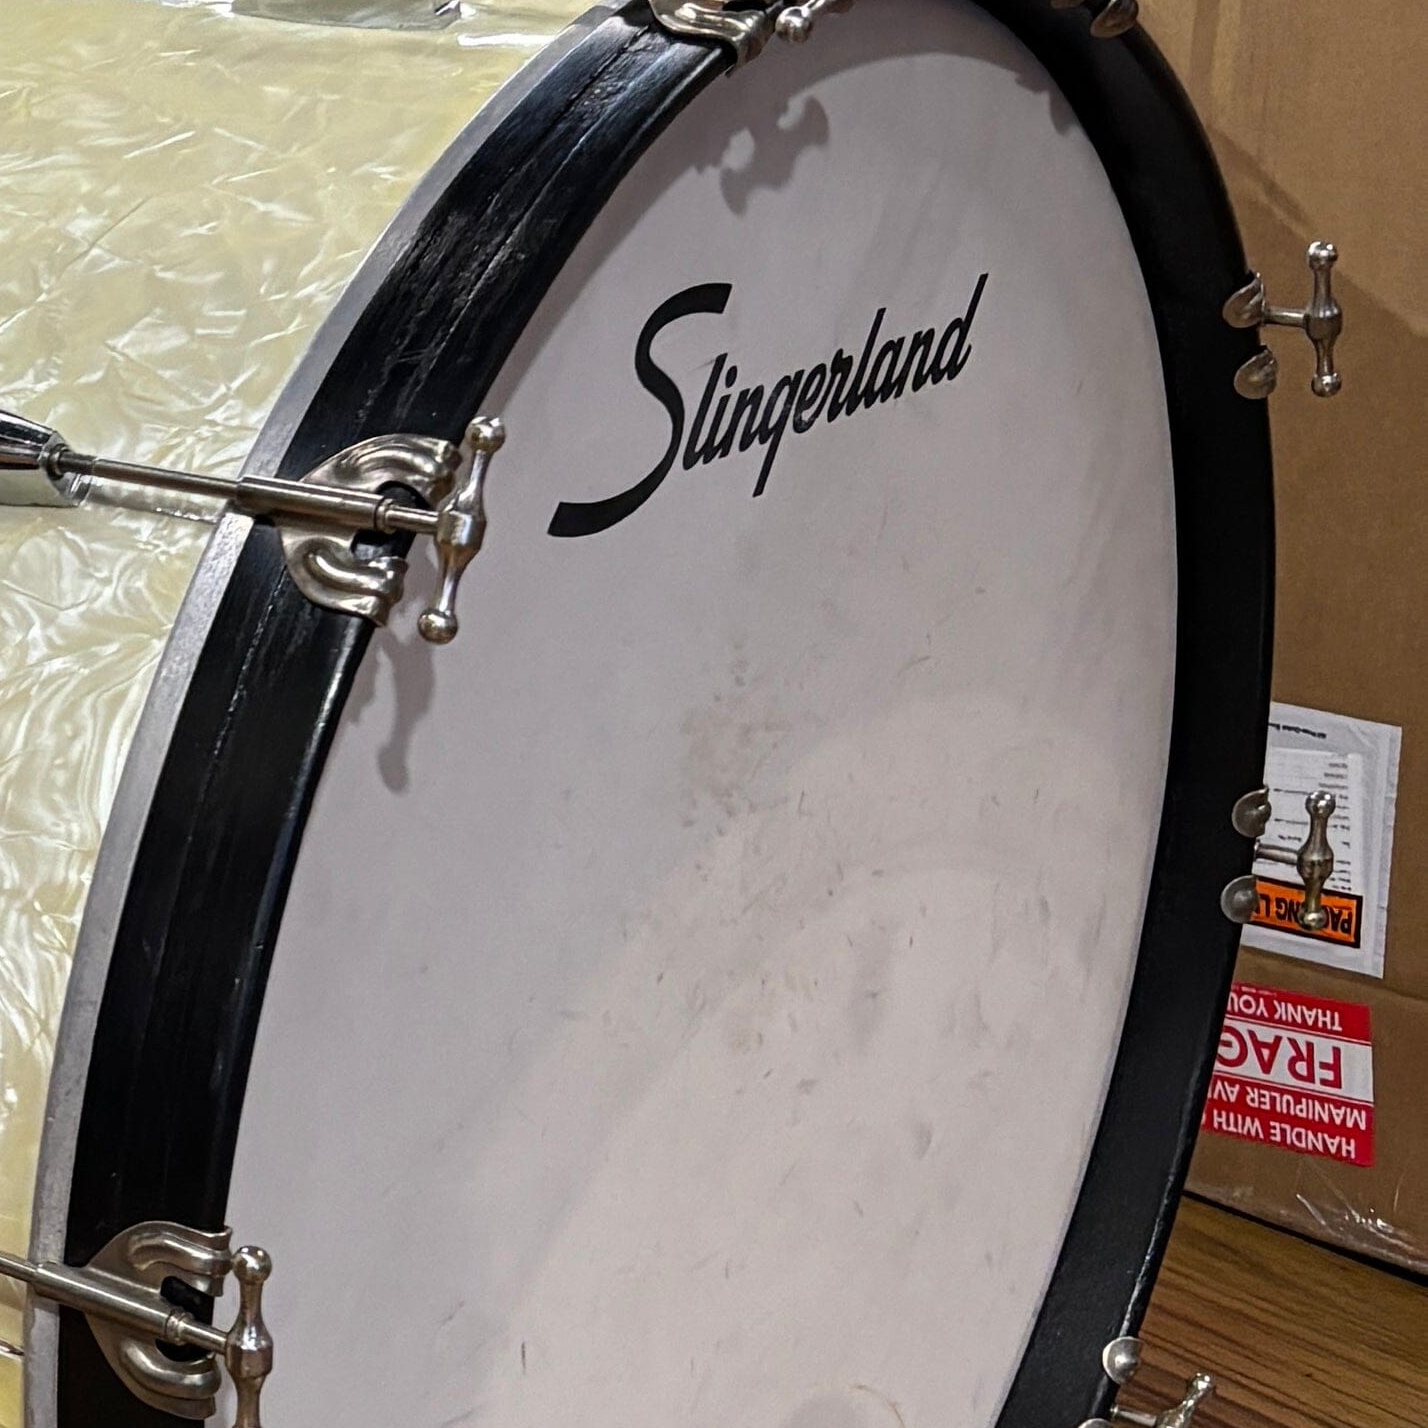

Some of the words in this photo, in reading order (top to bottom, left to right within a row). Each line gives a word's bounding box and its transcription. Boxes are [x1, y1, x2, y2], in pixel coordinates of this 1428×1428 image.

[547, 272, 989, 538] Slingerland
[1227, 991, 1269, 1018] YOU
[1273, 999, 1343, 1032] THANK
[1212, 1108, 1264, 1140] WITH
[1246, 1087, 1367, 1131] MANIPULER
[1269, 1121, 1356, 1160] HANDLE
